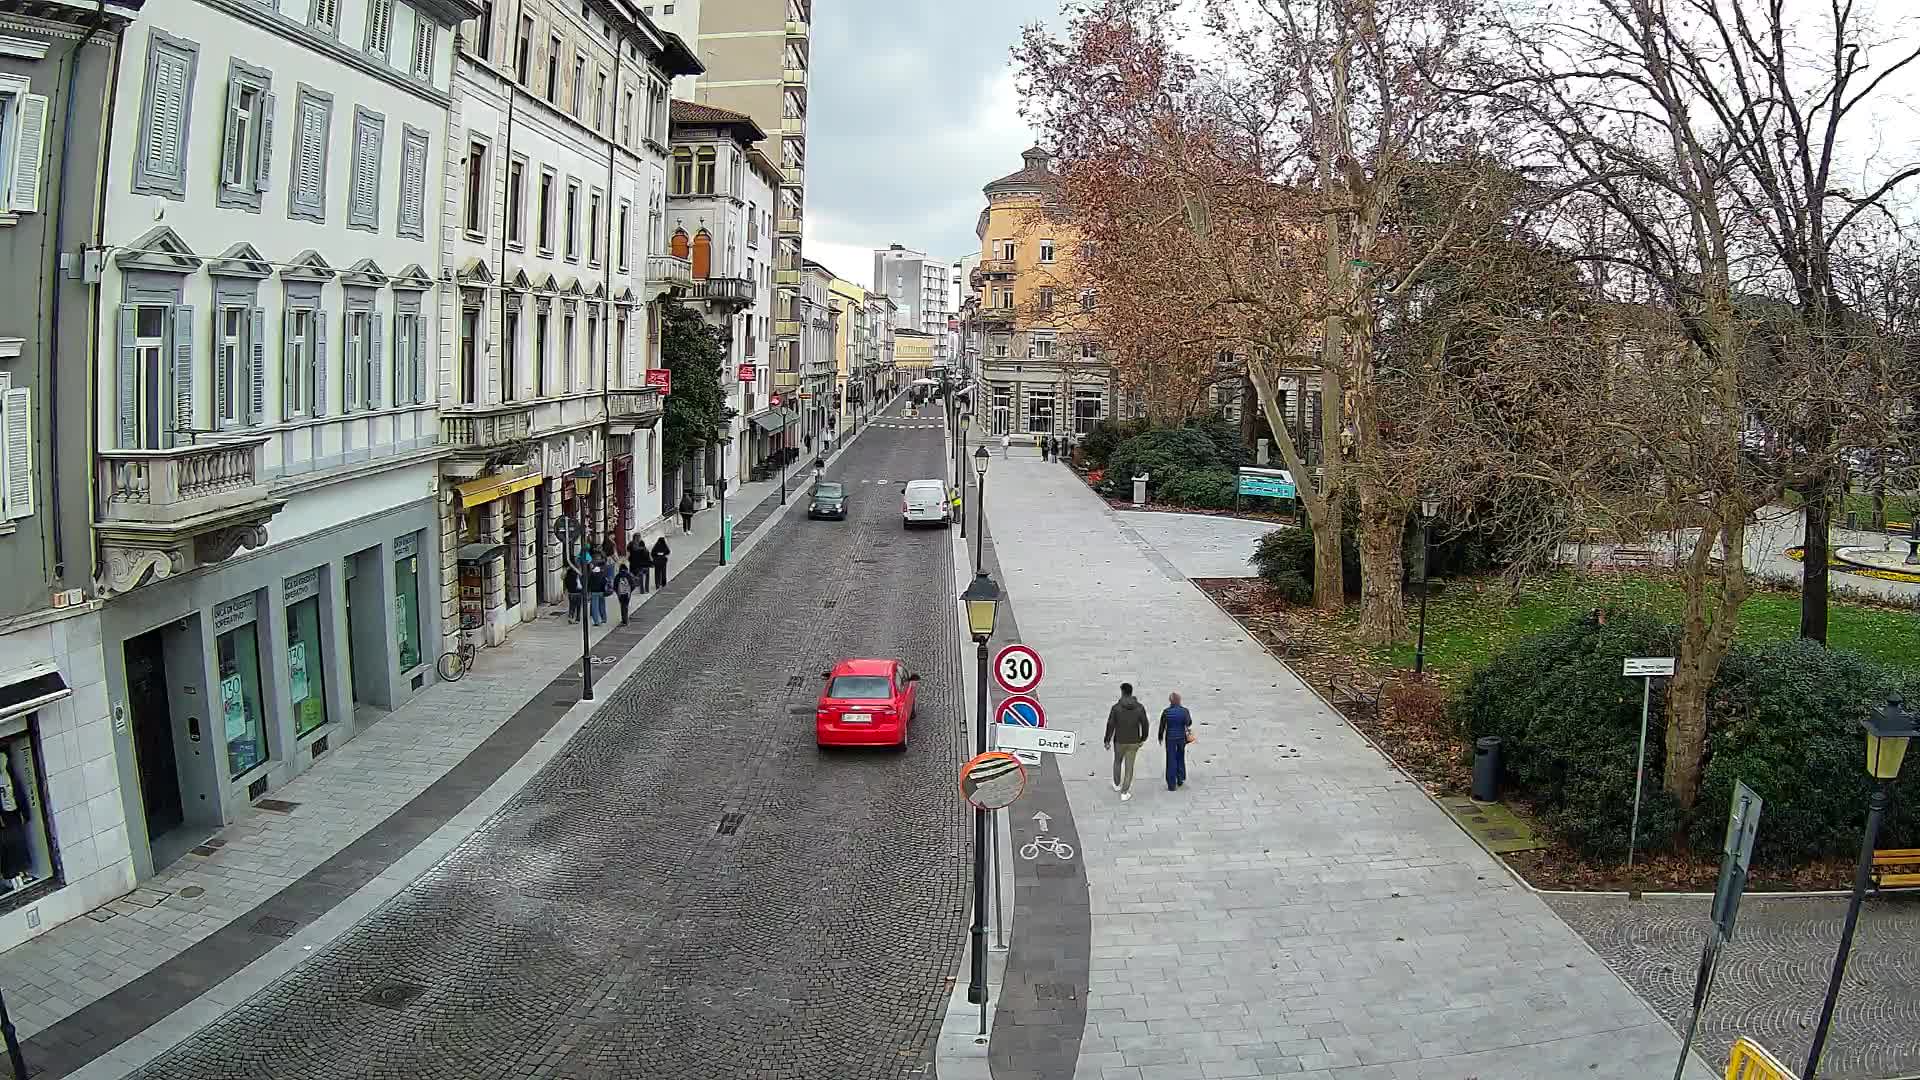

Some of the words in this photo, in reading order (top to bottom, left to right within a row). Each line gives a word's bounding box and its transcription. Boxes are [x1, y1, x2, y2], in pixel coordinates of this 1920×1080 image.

[288, 645, 304, 666] 130
[1005, 658, 1032, 680] 30
[223, 677, 240, 700] 130
[1038, 738, 1070, 749] Dante
